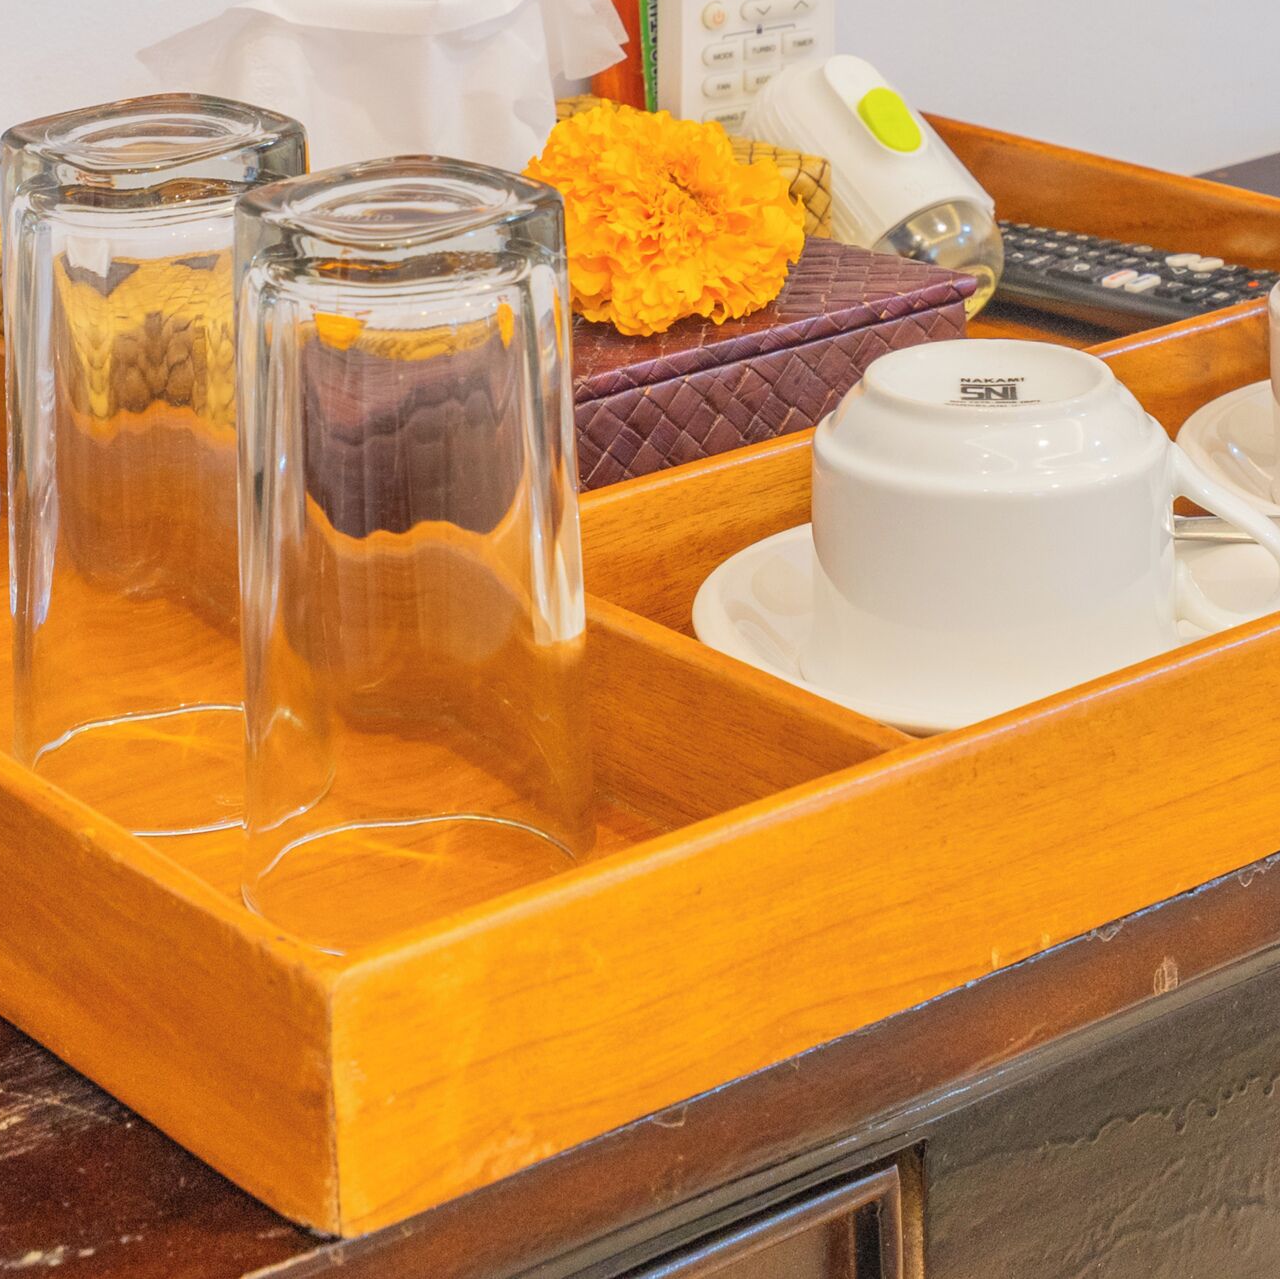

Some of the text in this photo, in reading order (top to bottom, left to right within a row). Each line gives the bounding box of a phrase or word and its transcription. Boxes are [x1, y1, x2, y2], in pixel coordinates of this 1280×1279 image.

[752, 45, 776, 54] TURBO
[713, 51, 733, 60] MODE
[960, 386, 1018, 401] SNI
